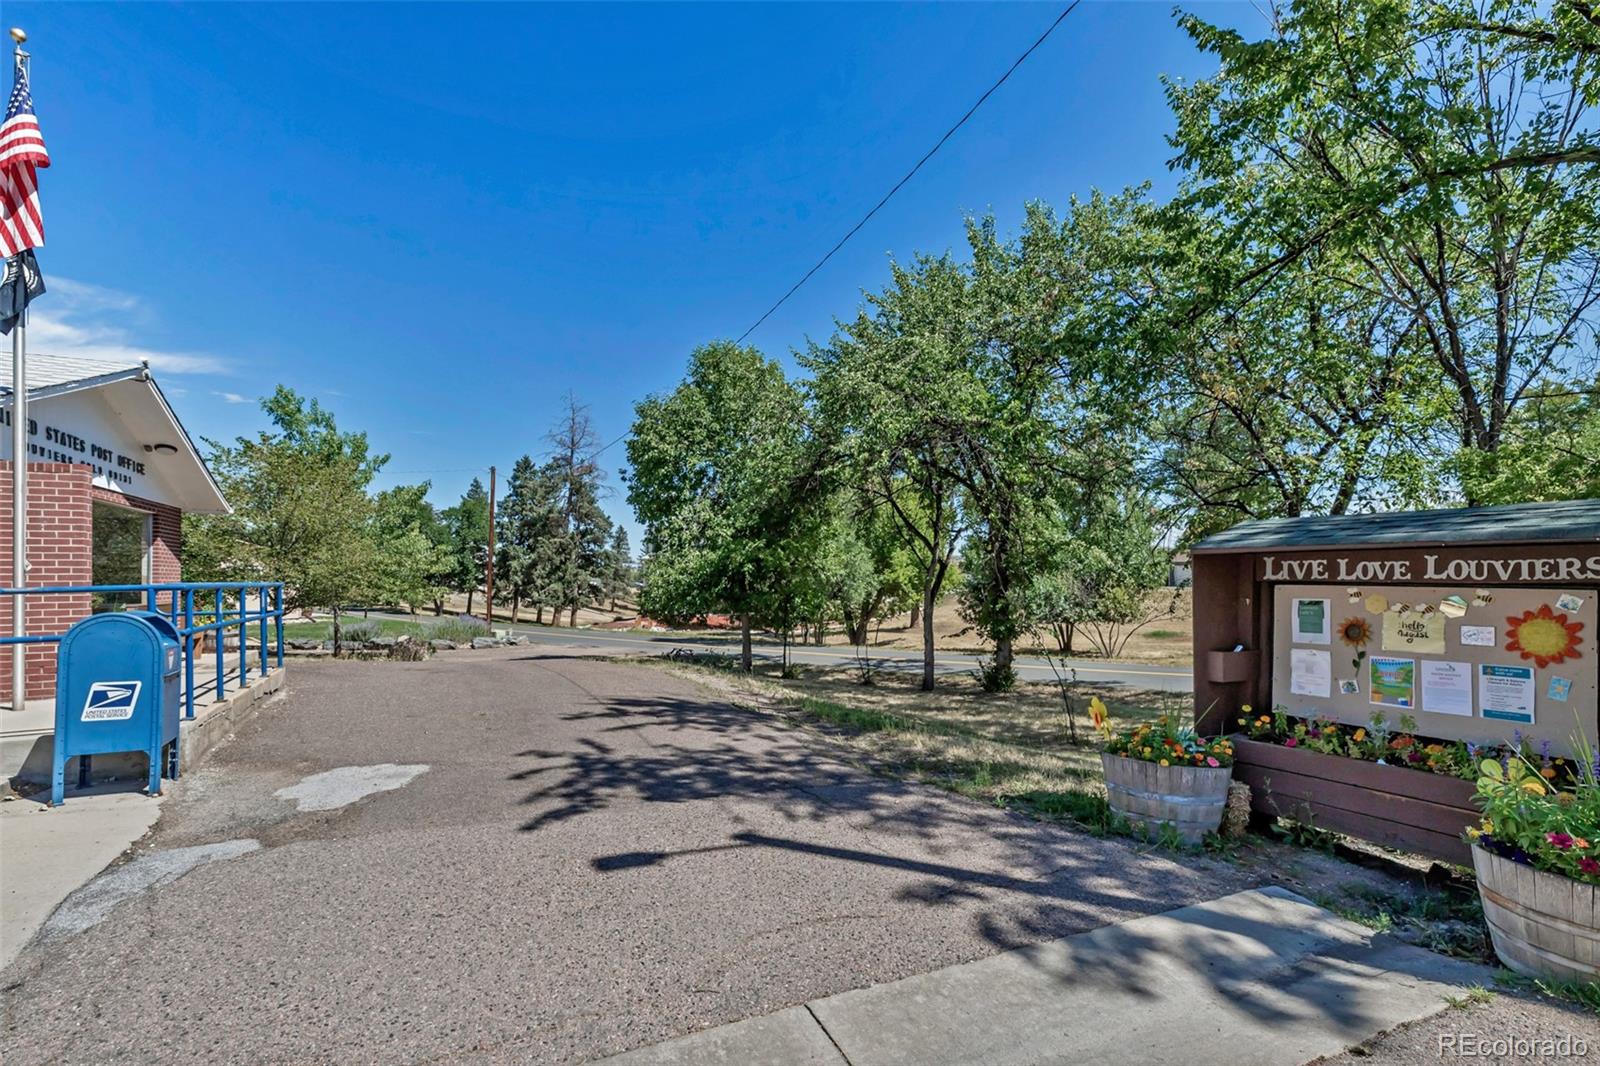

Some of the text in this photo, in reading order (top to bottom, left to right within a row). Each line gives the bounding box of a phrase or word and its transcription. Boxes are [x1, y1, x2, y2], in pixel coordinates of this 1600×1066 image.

[46, 426, 86, 453] STATES
[91, 444, 113, 463] POST
[117, 455, 145, 476] OFFICE
[1264, 555, 1600, 581] LIVE LOVE LOUVIERS
